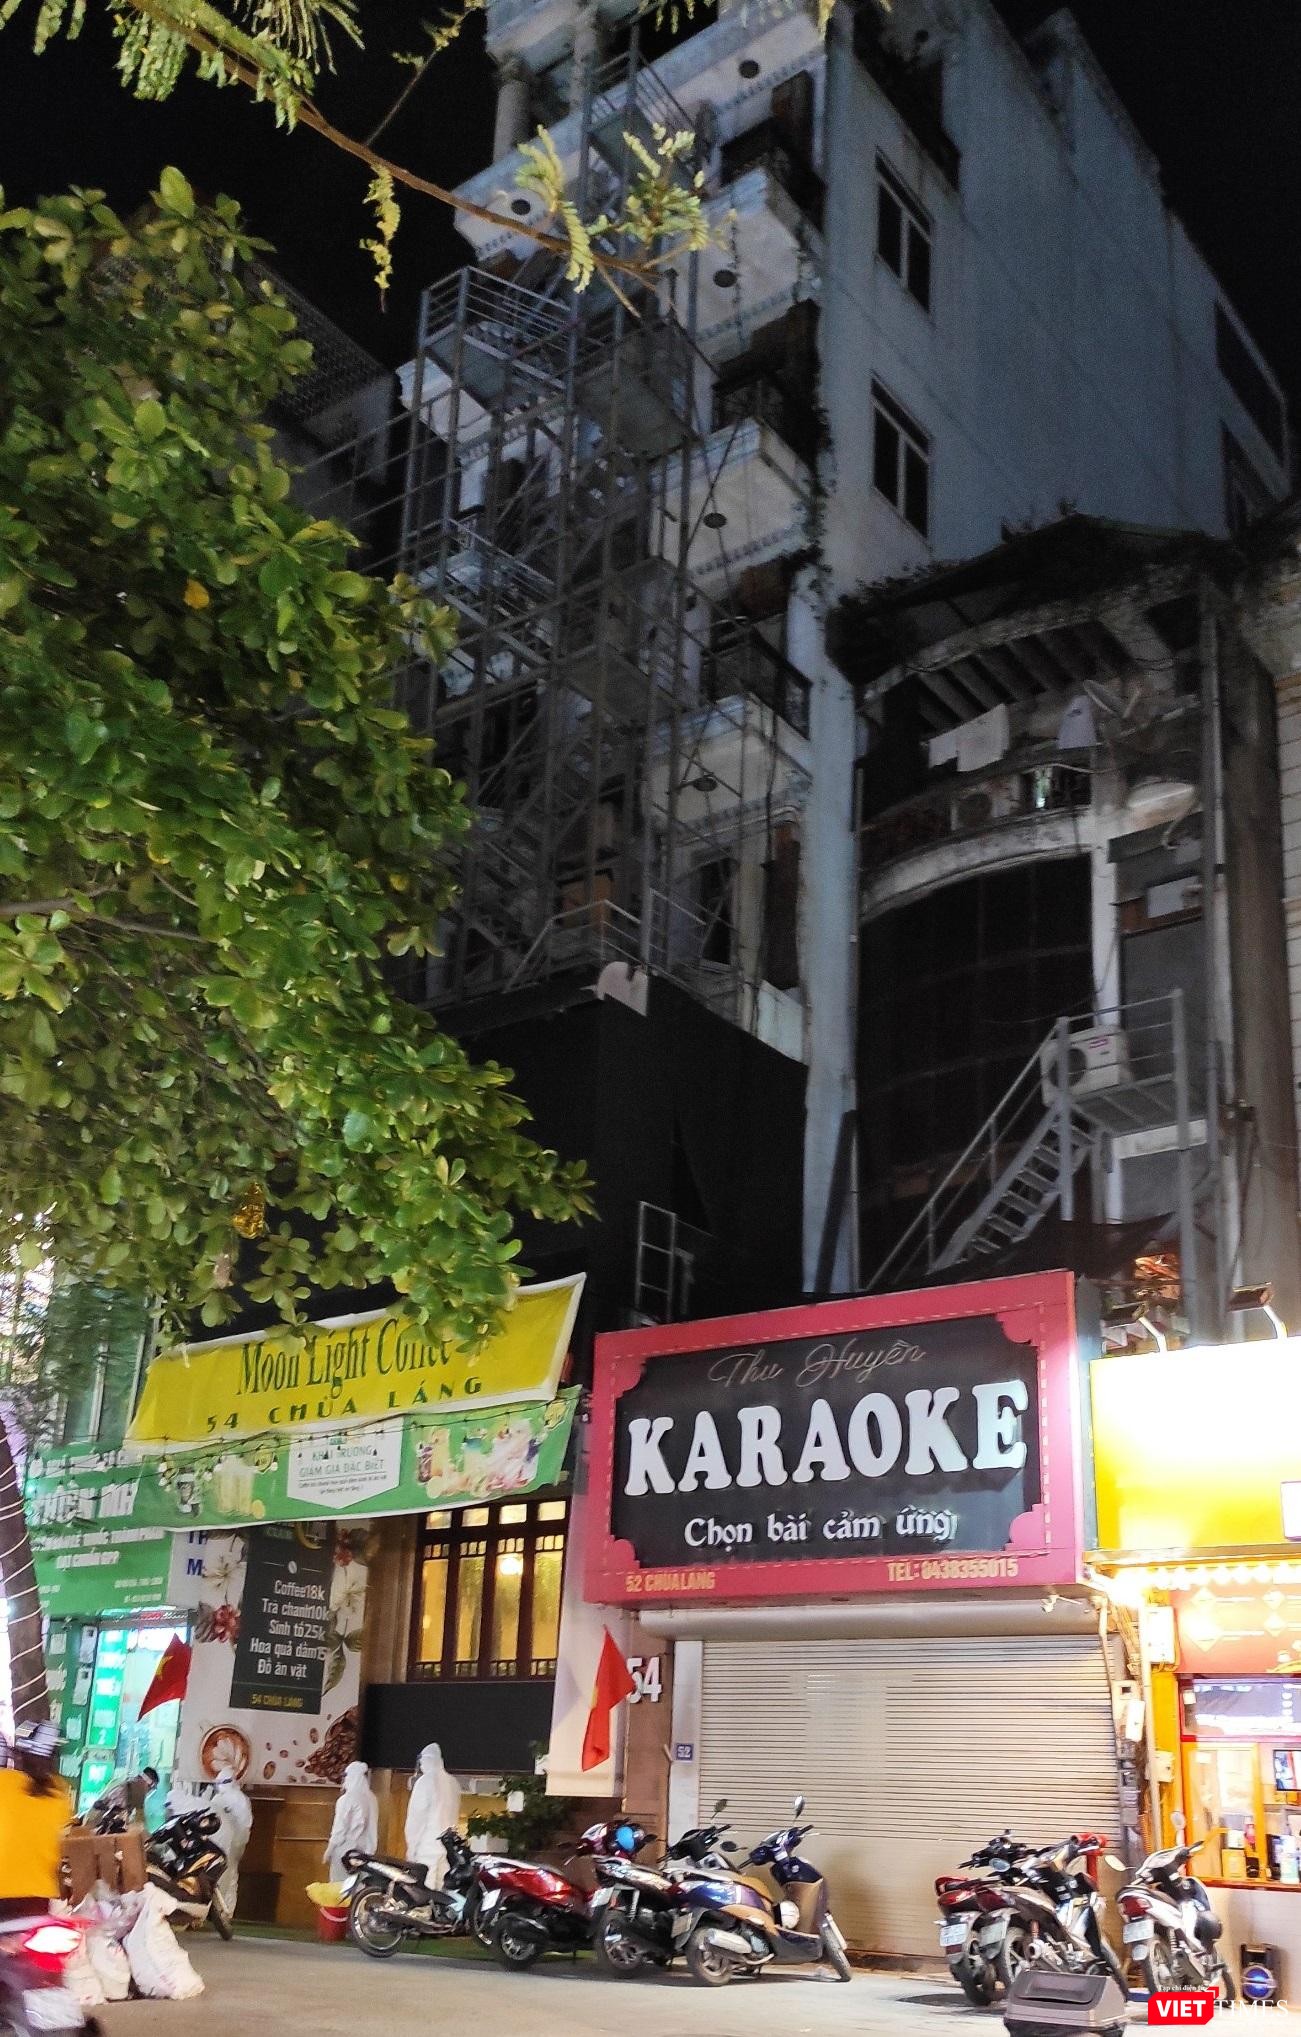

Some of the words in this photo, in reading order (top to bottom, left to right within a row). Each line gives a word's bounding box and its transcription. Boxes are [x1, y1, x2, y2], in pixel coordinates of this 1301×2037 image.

[236, 1341, 299, 1396] Moon
[306, 1328, 370, 1400] Light
[708, 1349, 784, 1387] Thu
[207, 1412, 239, 1433] 54
[388, 1377, 482, 1409] LÁNG
[624, 1379, 1029, 1496] KARAOKE
[684, 1517, 754, 1552] Chọn
[766, 1510, 809, 1542] bài
[822, 1509, 881, 1539] cảm
[895, 1504, 959, 1542] ứng
[625, 1574, 643, 1593] 52
[250, 1637, 271, 1654] Hoa
[626, 1656, 662, 1703] 54
